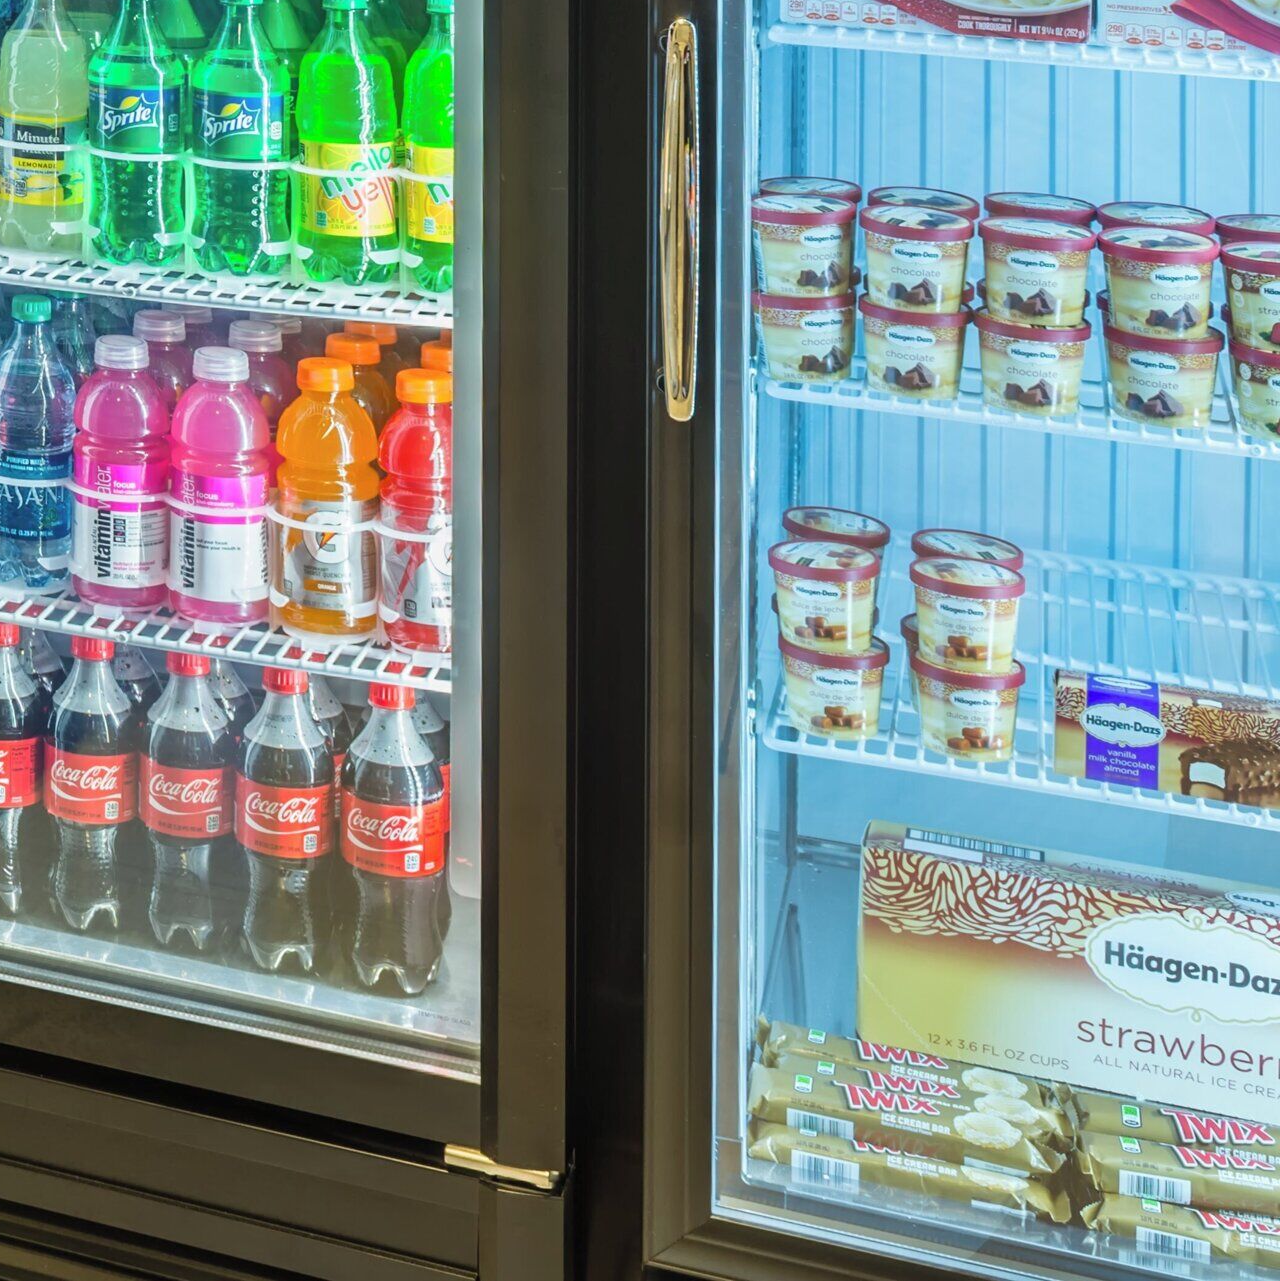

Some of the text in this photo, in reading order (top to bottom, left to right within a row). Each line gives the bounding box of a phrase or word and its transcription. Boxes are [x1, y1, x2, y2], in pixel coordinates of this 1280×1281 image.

[958, 20, 973, 29] COOK
[102, 107, 151, 131] Sprite
[204, 110, 252, 138] Sprite
[16, 129, 60, 144] Minute
[18, 160, 58, 169] LEMONADE
[891, 265, 941, 278] chocolate
[1006, 275, 1057, 288] chocolate
[885, 349, 935, 362] chocolate
[114, 481, 136, 489] focus
[197, 491, 218, 500] focus
[1086, 713, 1161, 736] Häagen-Dazs
[1088, 753, 1155, 771] milk chocolate
[1107, 749, 1137, 759] vanilla
[1104, 765, 1139, 776] almond
[149, 773, 221, 803] Coca-Cola
[245, 791, 320, 824] Coca-Cola
[1104, 940, 1280, 996] Häagen-Daz
[927, 1033, 1070, 1070] 12 3.6 FL OZ CUPS
[907, 1067, 938, 1081] CREAM
[1093, 1054, 1237, 1091] ALL NATURAL ICE
[832, 1079, 940, 1116] TWIX
[881, 1113, 951, 1135] ICE CREAM BAR
[1160, 1108, 1276, 1144] TWIX
[887, 1154, 957, 1177] ICE CREAM BAR
